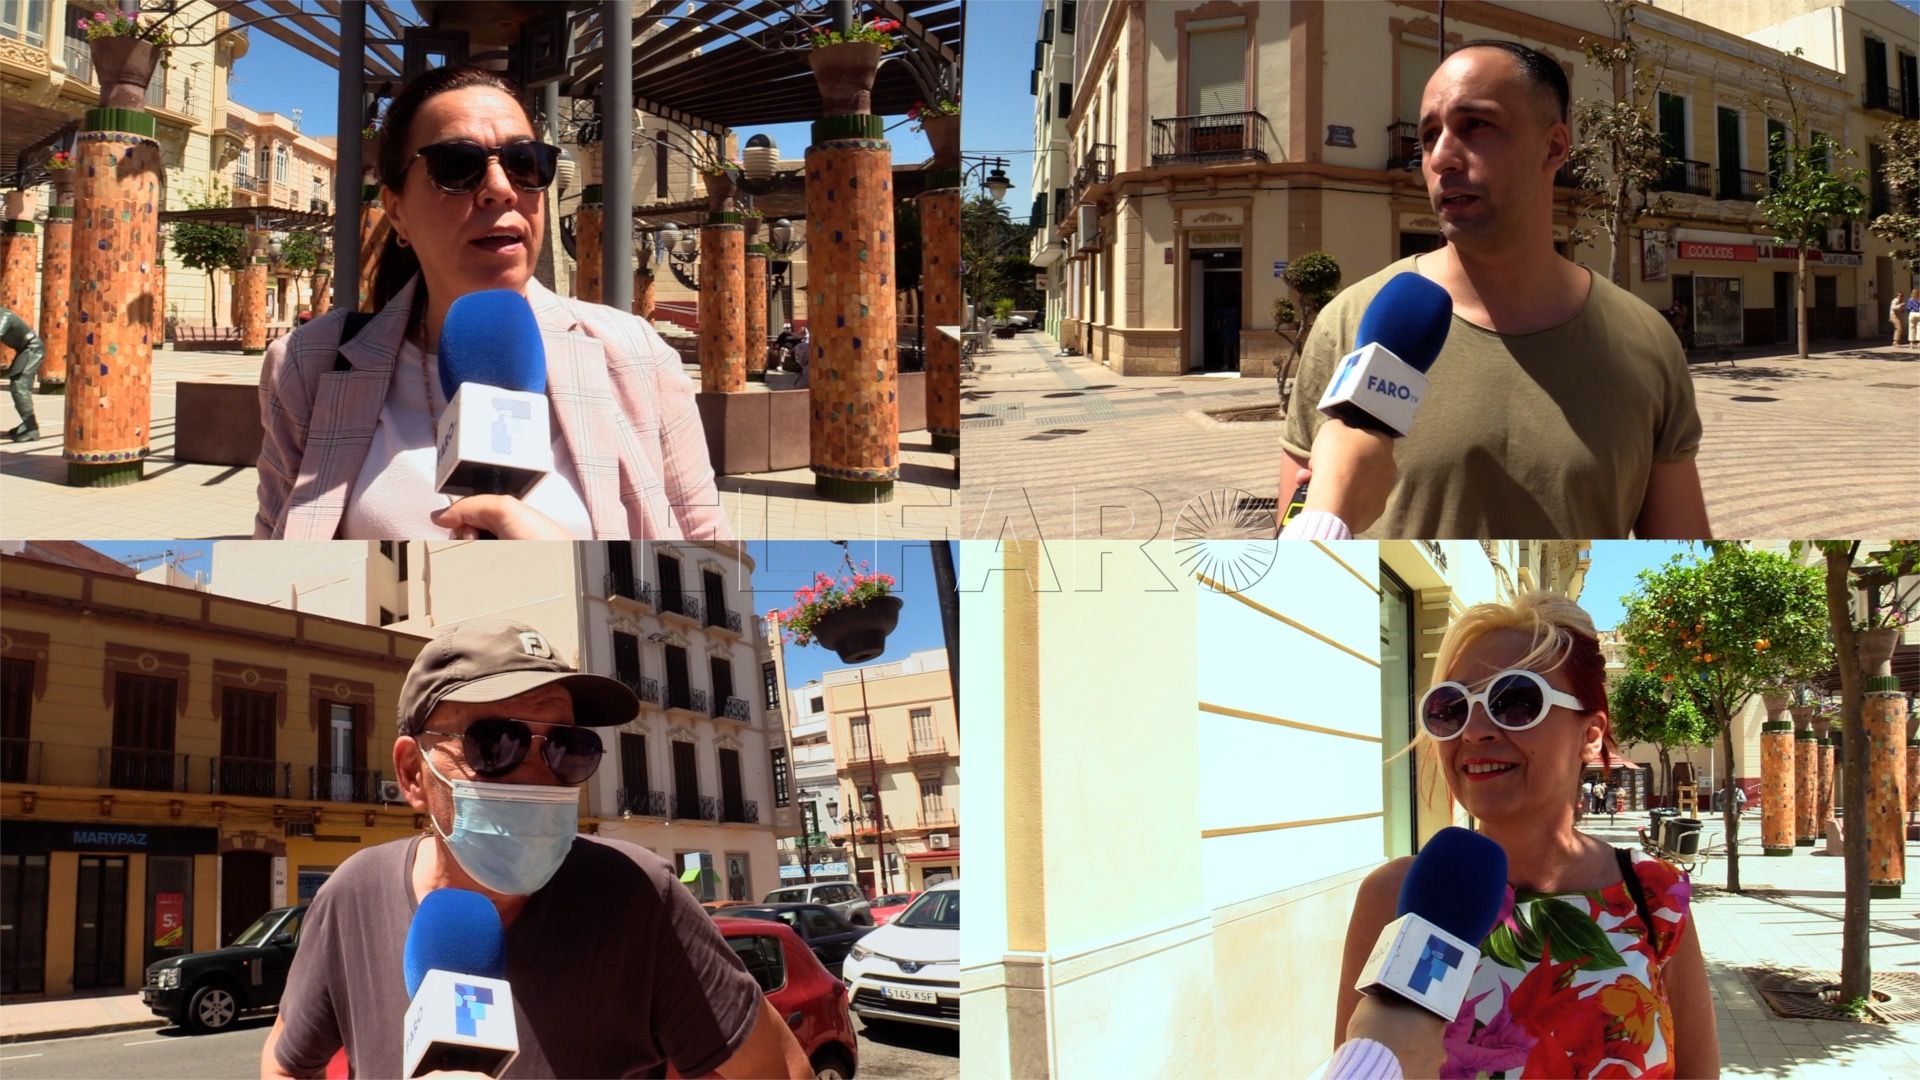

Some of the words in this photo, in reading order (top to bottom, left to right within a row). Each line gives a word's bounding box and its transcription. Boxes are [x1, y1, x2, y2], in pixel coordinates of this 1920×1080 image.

[1367, 375, 1411, 401] FARO
[73, 831, 148, 845] MARYPAZ
[887, 988, 912, 1000] 5145
[914, 991, 934, 1003] KSF
